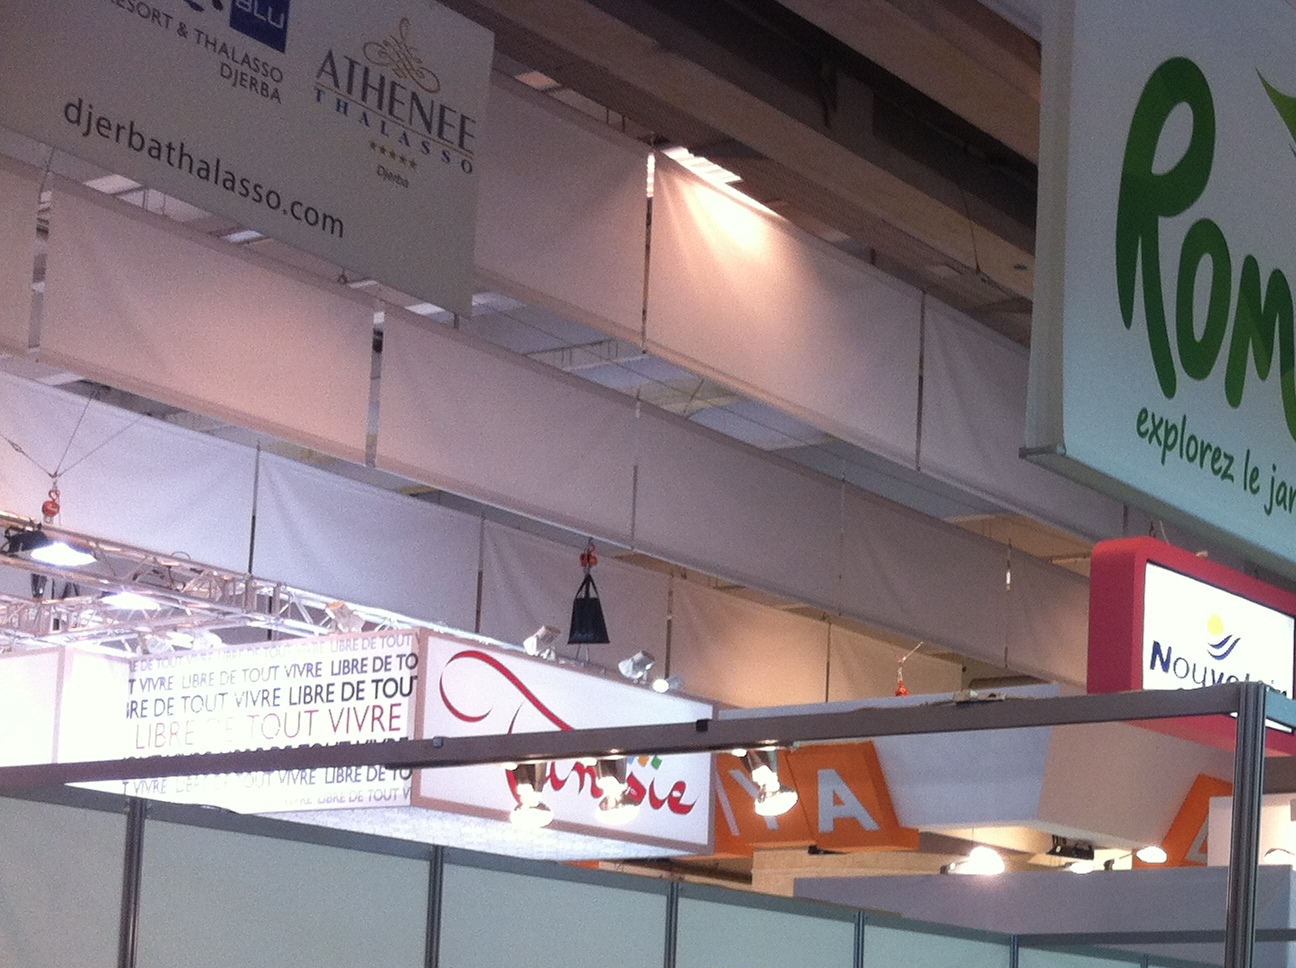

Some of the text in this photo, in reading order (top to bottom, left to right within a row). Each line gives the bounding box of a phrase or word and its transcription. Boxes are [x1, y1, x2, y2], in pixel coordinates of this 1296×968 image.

[176, 21, 189, 39] &
[194, 28, 284, 83] THALASSO
[220, 62, 282, 104] DJERBA
[315, 48, 477, 155] ATHENEE
[313, 87, 473, 174] THALASSO
[63, 98, 345, 238] djerbathalasso.com
[376, 164, 410, 189] Djerba
[1136, 407, 1235, 483] explorez
[1243, 448, 1260, 495] le
[330, 638, 359, 653] LIBRE
[361, 637, 377, 650] DE
[381, 634, 412, 649] TOUT
[139, 675, 174, 692] VIVRE
[181, 671, 215, 689] LIBRE
[219, 670, 237, 686] DE
[243, 665, 280, 684] TOUT
[284, 661, 323, 678] VIVRE
[331, 657, 369, 676] LIBRE
[372, 655, 392, 673] DE
[396, 652, 419, 670] TO
[154, 697, 175, 717] DE
[181, 692, 228, 714] TOUT
[234, 687, 282, 708] VIVRE
[289, 682, 335, 706] LIBRE
[341, 680, 366, 702] DE
[136, 719, 195, 749] LIBRE
[246, 709, 319, 740] TOUT
[328, 702, 402, 734] VIVRE
[133, 779, 167, 796] VIVRE
[278, 768, 316, 786] VIVRE
[324, 766, 362, 785] LIBRE
[366, 765, 386, 782] DE
[368, 787, 399, 801] TOUT
